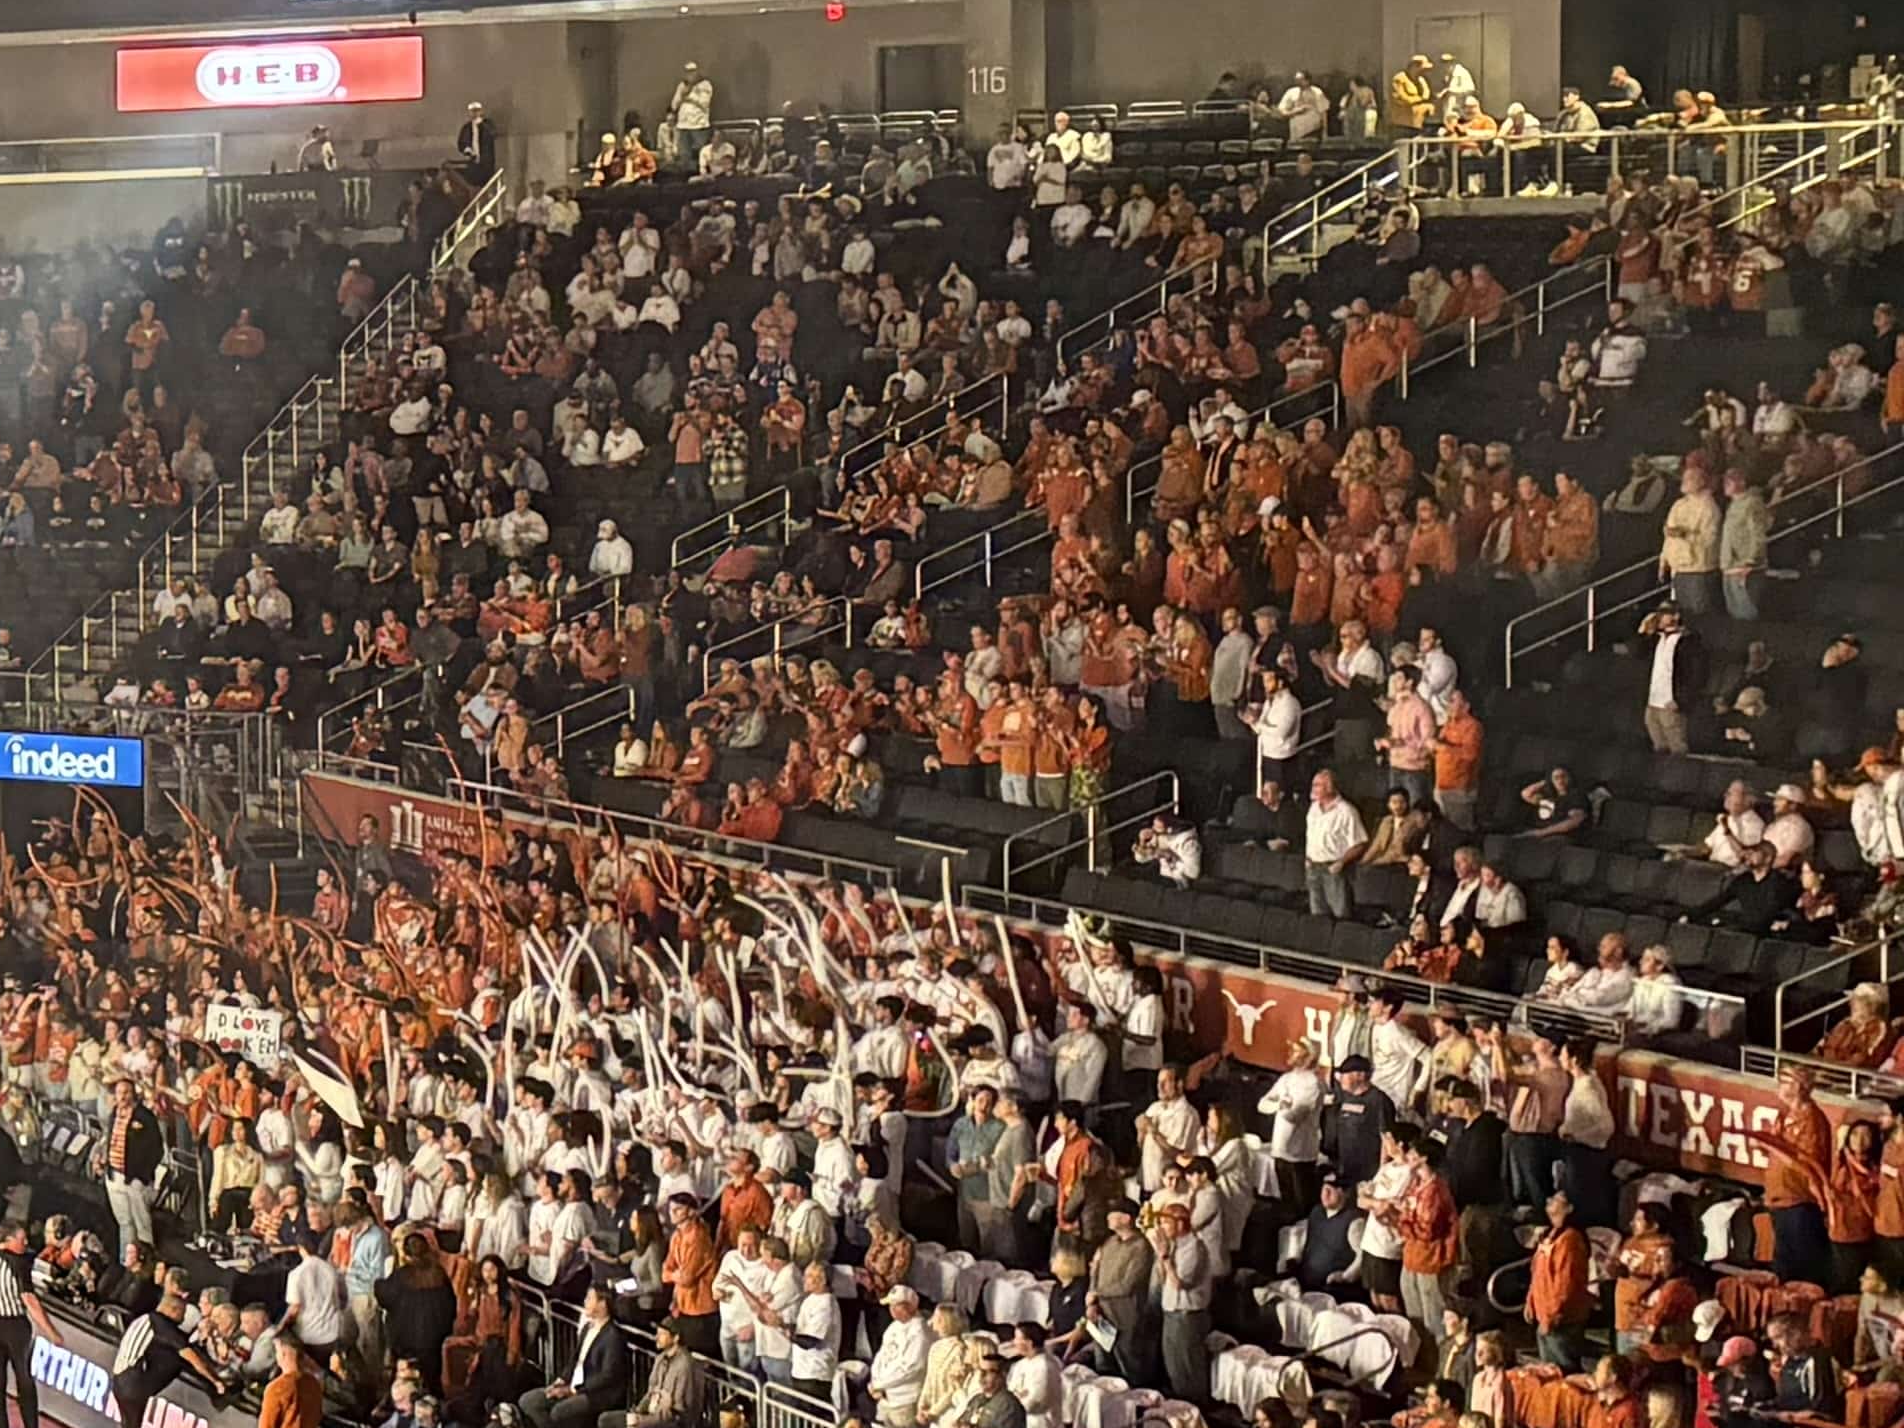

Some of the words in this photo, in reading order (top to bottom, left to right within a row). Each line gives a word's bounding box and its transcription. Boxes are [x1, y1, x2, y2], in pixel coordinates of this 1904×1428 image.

[968, 66, 1007, 94] 116
[10, 736, 117, 782] indeed
[30, 1335, 109, 1414] RTHUR
